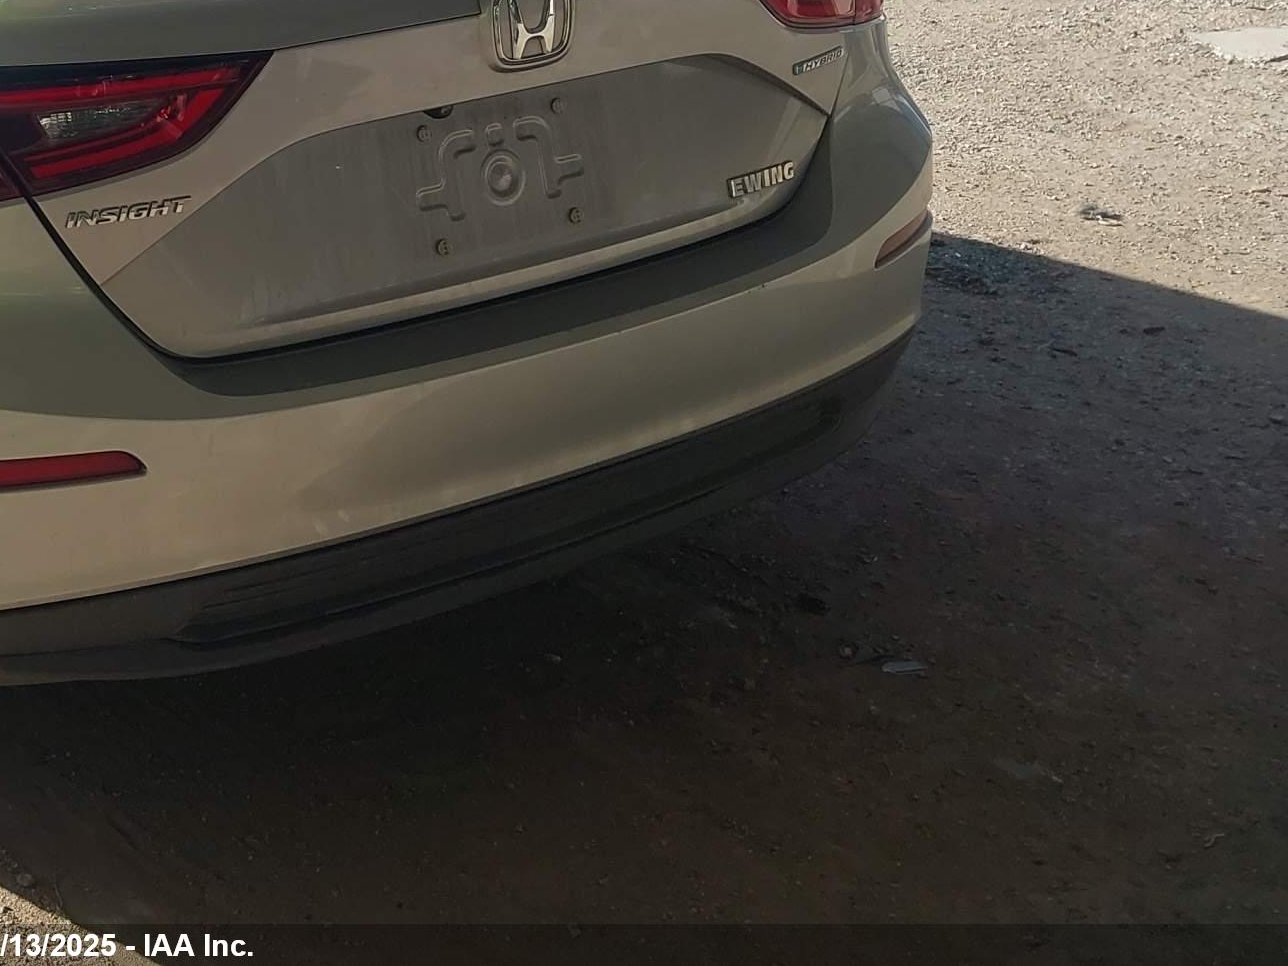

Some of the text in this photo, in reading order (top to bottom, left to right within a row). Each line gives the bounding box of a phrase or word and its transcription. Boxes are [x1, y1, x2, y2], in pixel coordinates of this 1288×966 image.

[803, 47, 844, 72] HYBRID
[729, 161, 795, 198] EWING
[65, 195, 192, 229] INSIGHT
